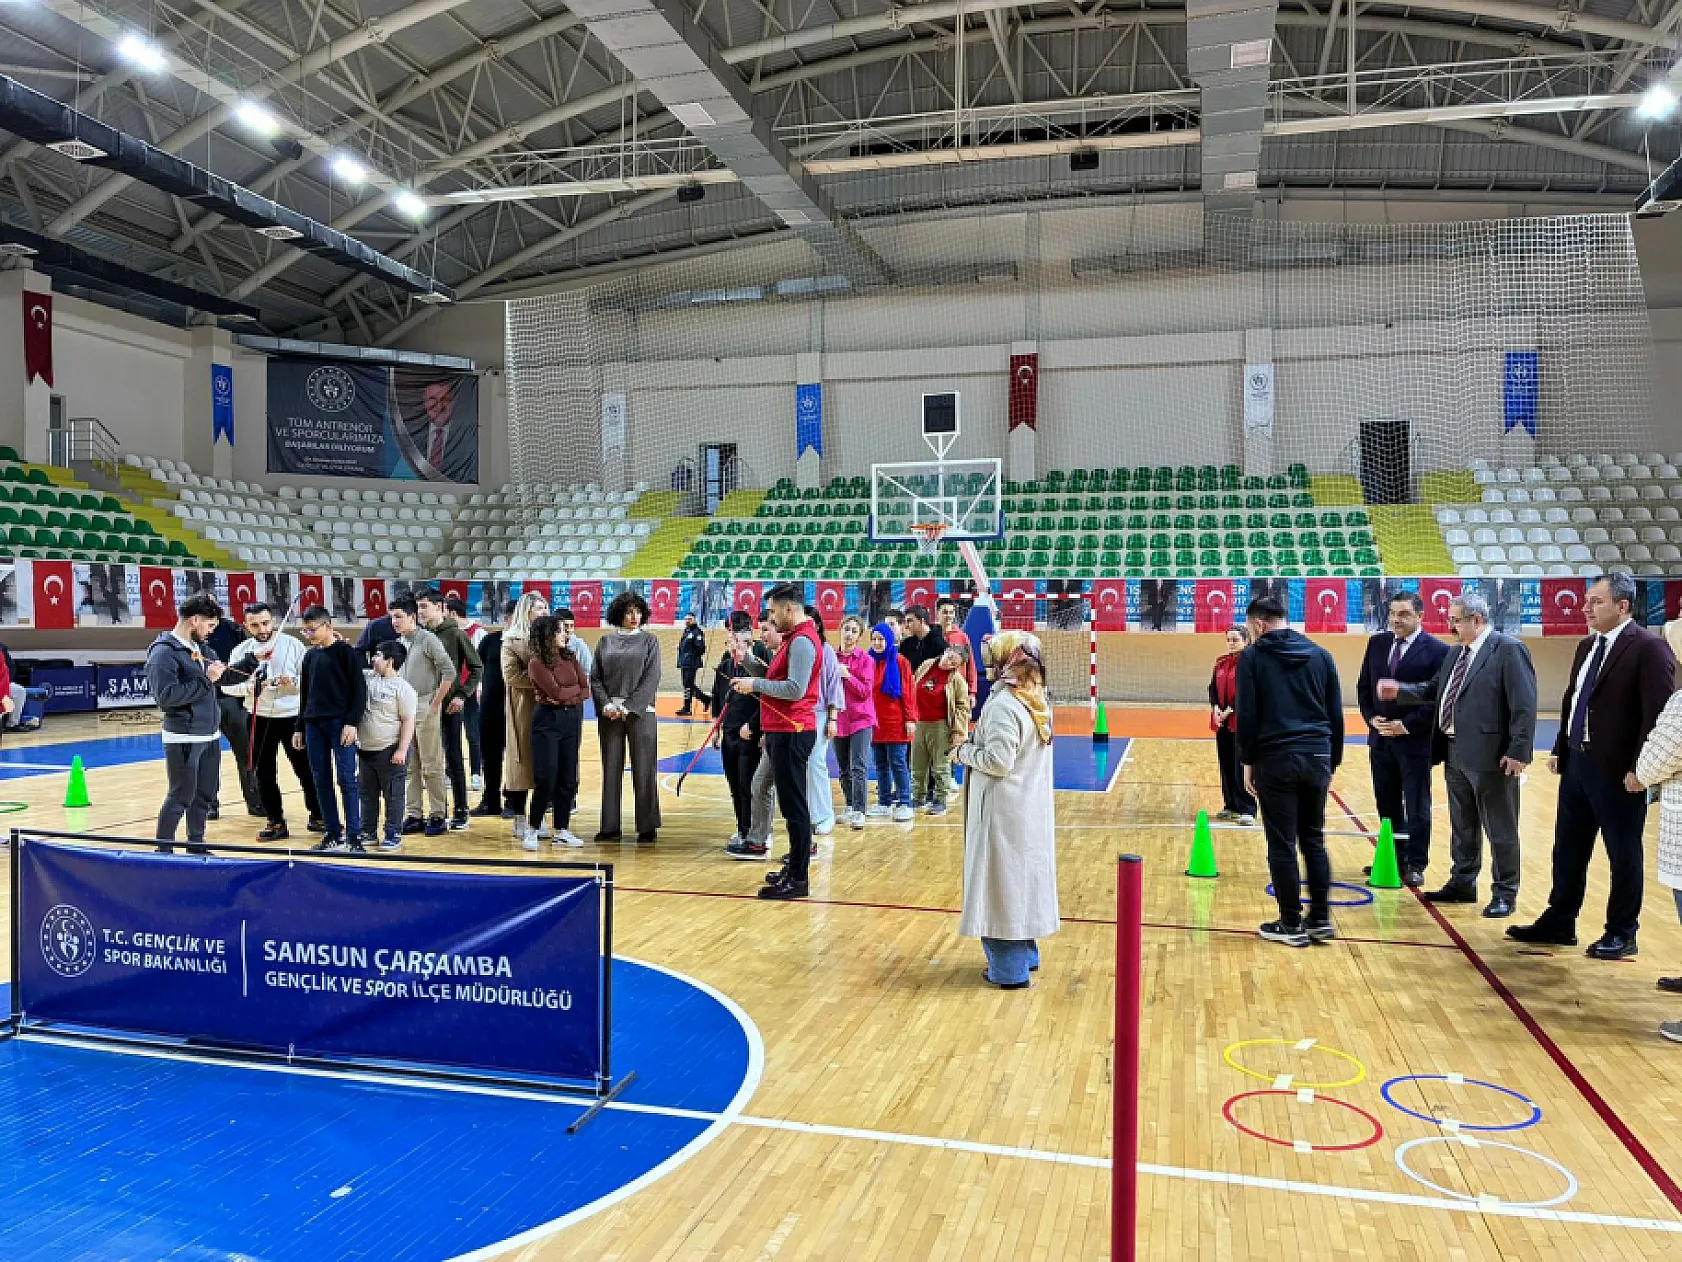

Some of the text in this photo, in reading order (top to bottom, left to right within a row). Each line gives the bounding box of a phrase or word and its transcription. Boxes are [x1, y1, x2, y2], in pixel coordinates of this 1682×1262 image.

[275, 427, 289, 437] VE
[102, 928, 226, 954] T.C. GENÇLİK VE
[104, 948, 228, 974] SPOR BAKANLIĞI
[263, 939, 513, 981] SAMSUN ÇARŞAMBA
[265, 970, 573, 1010] GENÇLİK VE SPOR İLÇE MÜDÜRLÜĞÜ
